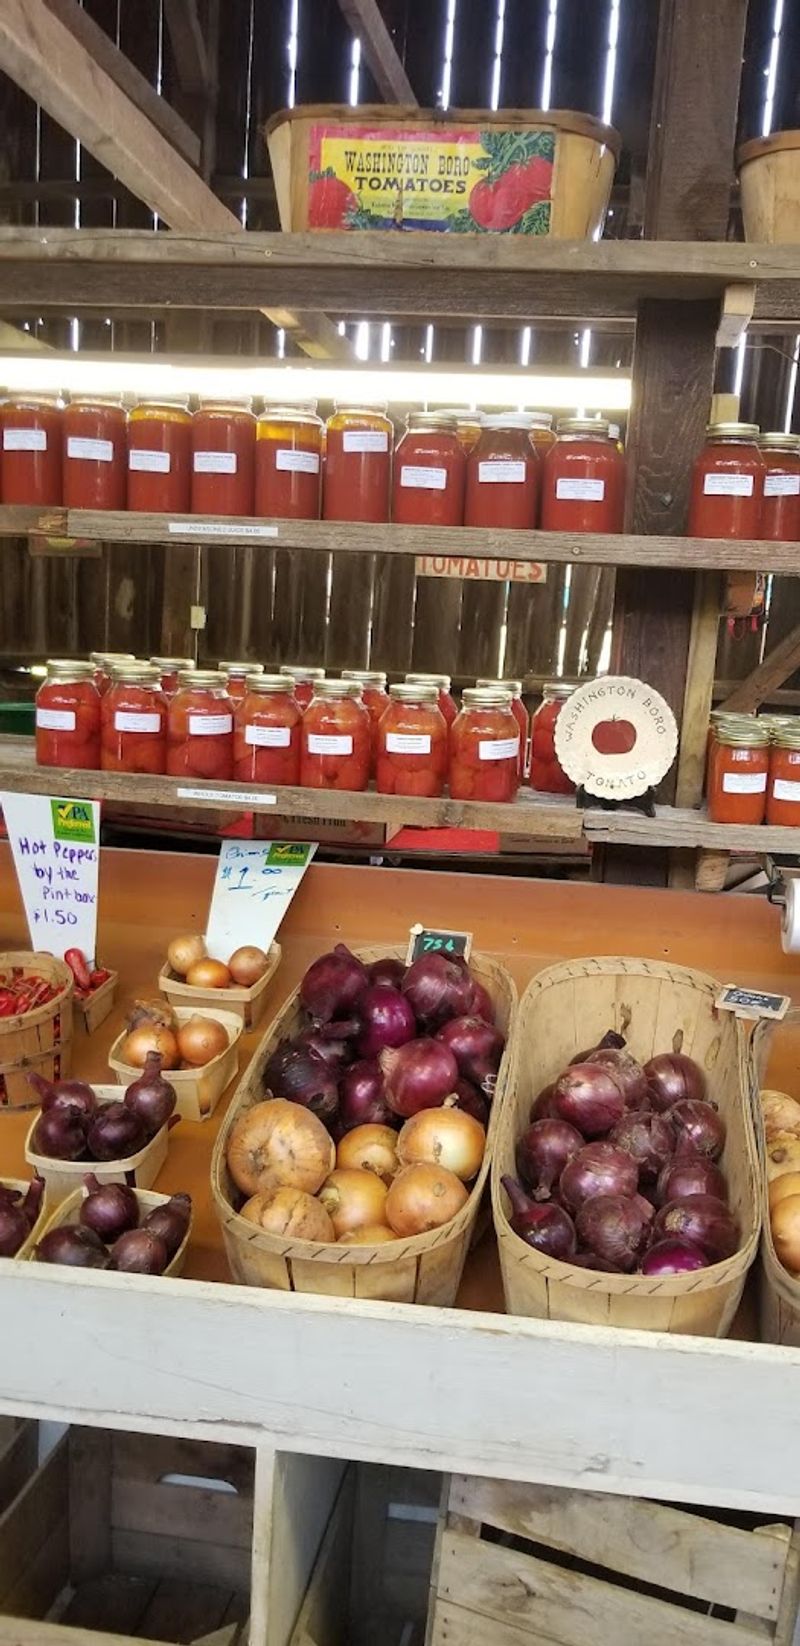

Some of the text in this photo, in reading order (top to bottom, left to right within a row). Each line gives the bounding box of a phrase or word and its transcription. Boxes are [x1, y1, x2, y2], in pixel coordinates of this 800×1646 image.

[344, 150, 470, 176] WASHINGTON BORO
[355, 176, 466, 194] TOMATOES
[565, 685, 666, 742] WASHINGTON BORO
[585, 770, 647, 790] TOMATO
[19, 837, 47, 855] Hot
[33, 863, 80, 885] by the
[74, 888, 96, 904] box
[33, 908, 78, 926] $1.50
